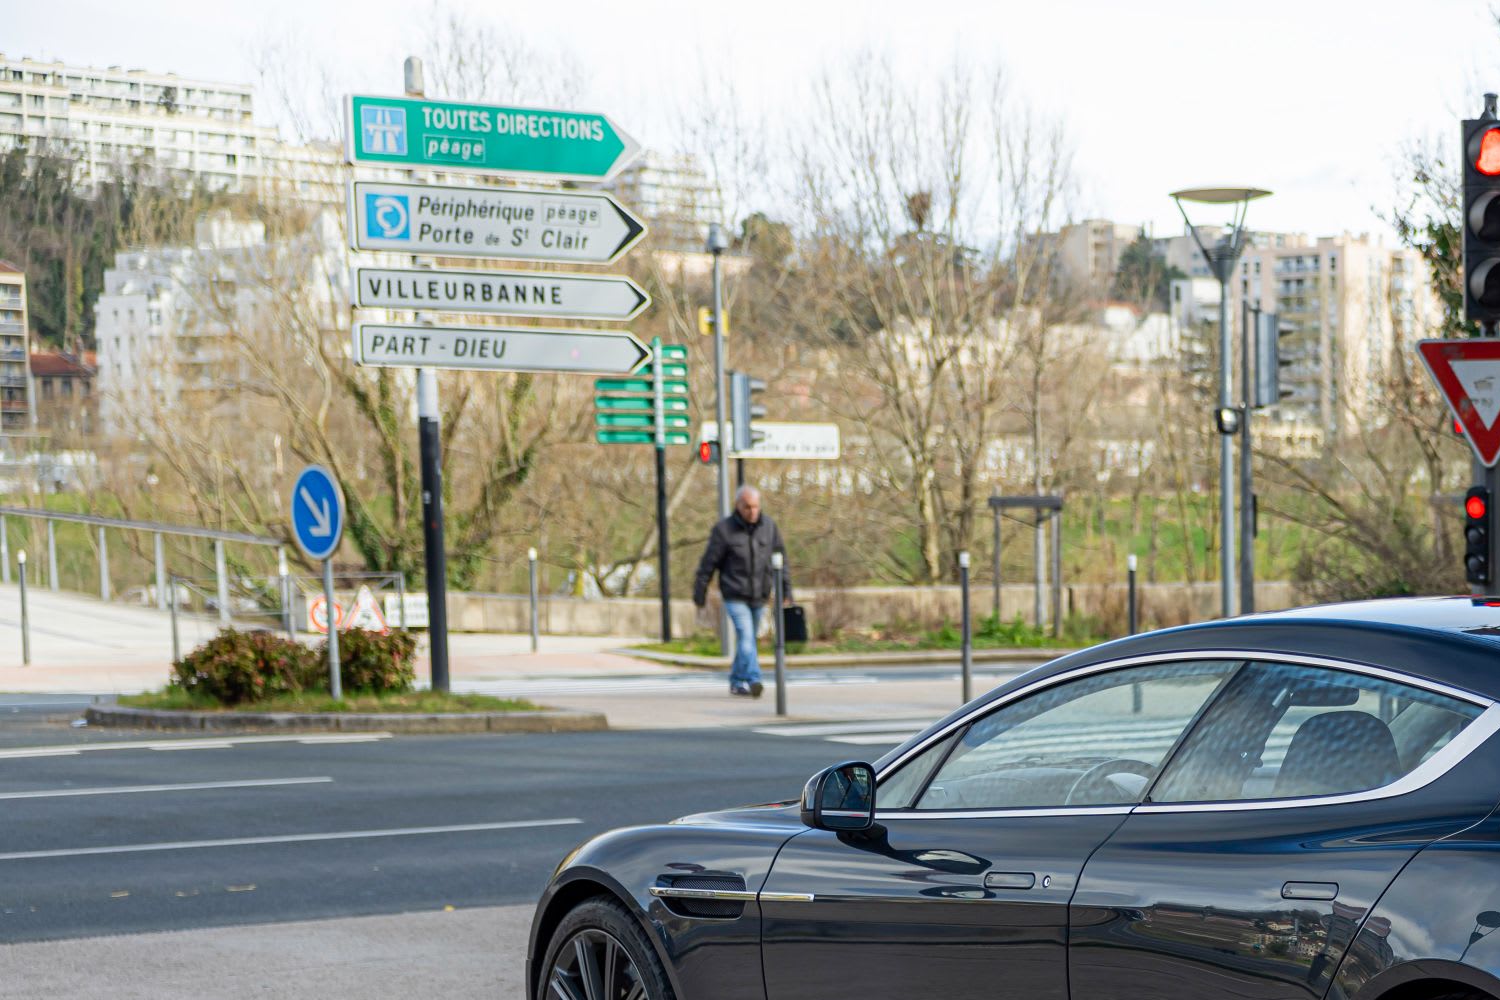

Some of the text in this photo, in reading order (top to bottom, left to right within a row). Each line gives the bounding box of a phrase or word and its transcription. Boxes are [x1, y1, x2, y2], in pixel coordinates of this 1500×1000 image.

[422, 107, 604, 141] TOUTES DIRECTIONS
[428, 138, 483, 160] péage
[417, 195, 534, 224] Périphérique
[546, 204, 598, 225] péage
[418, 223, 474, 244] Porte
[485, 233, 500, 246] de
[541, 230, 588, 250] Clair
[369, 279, 562, 305] VILLEURBANNE
